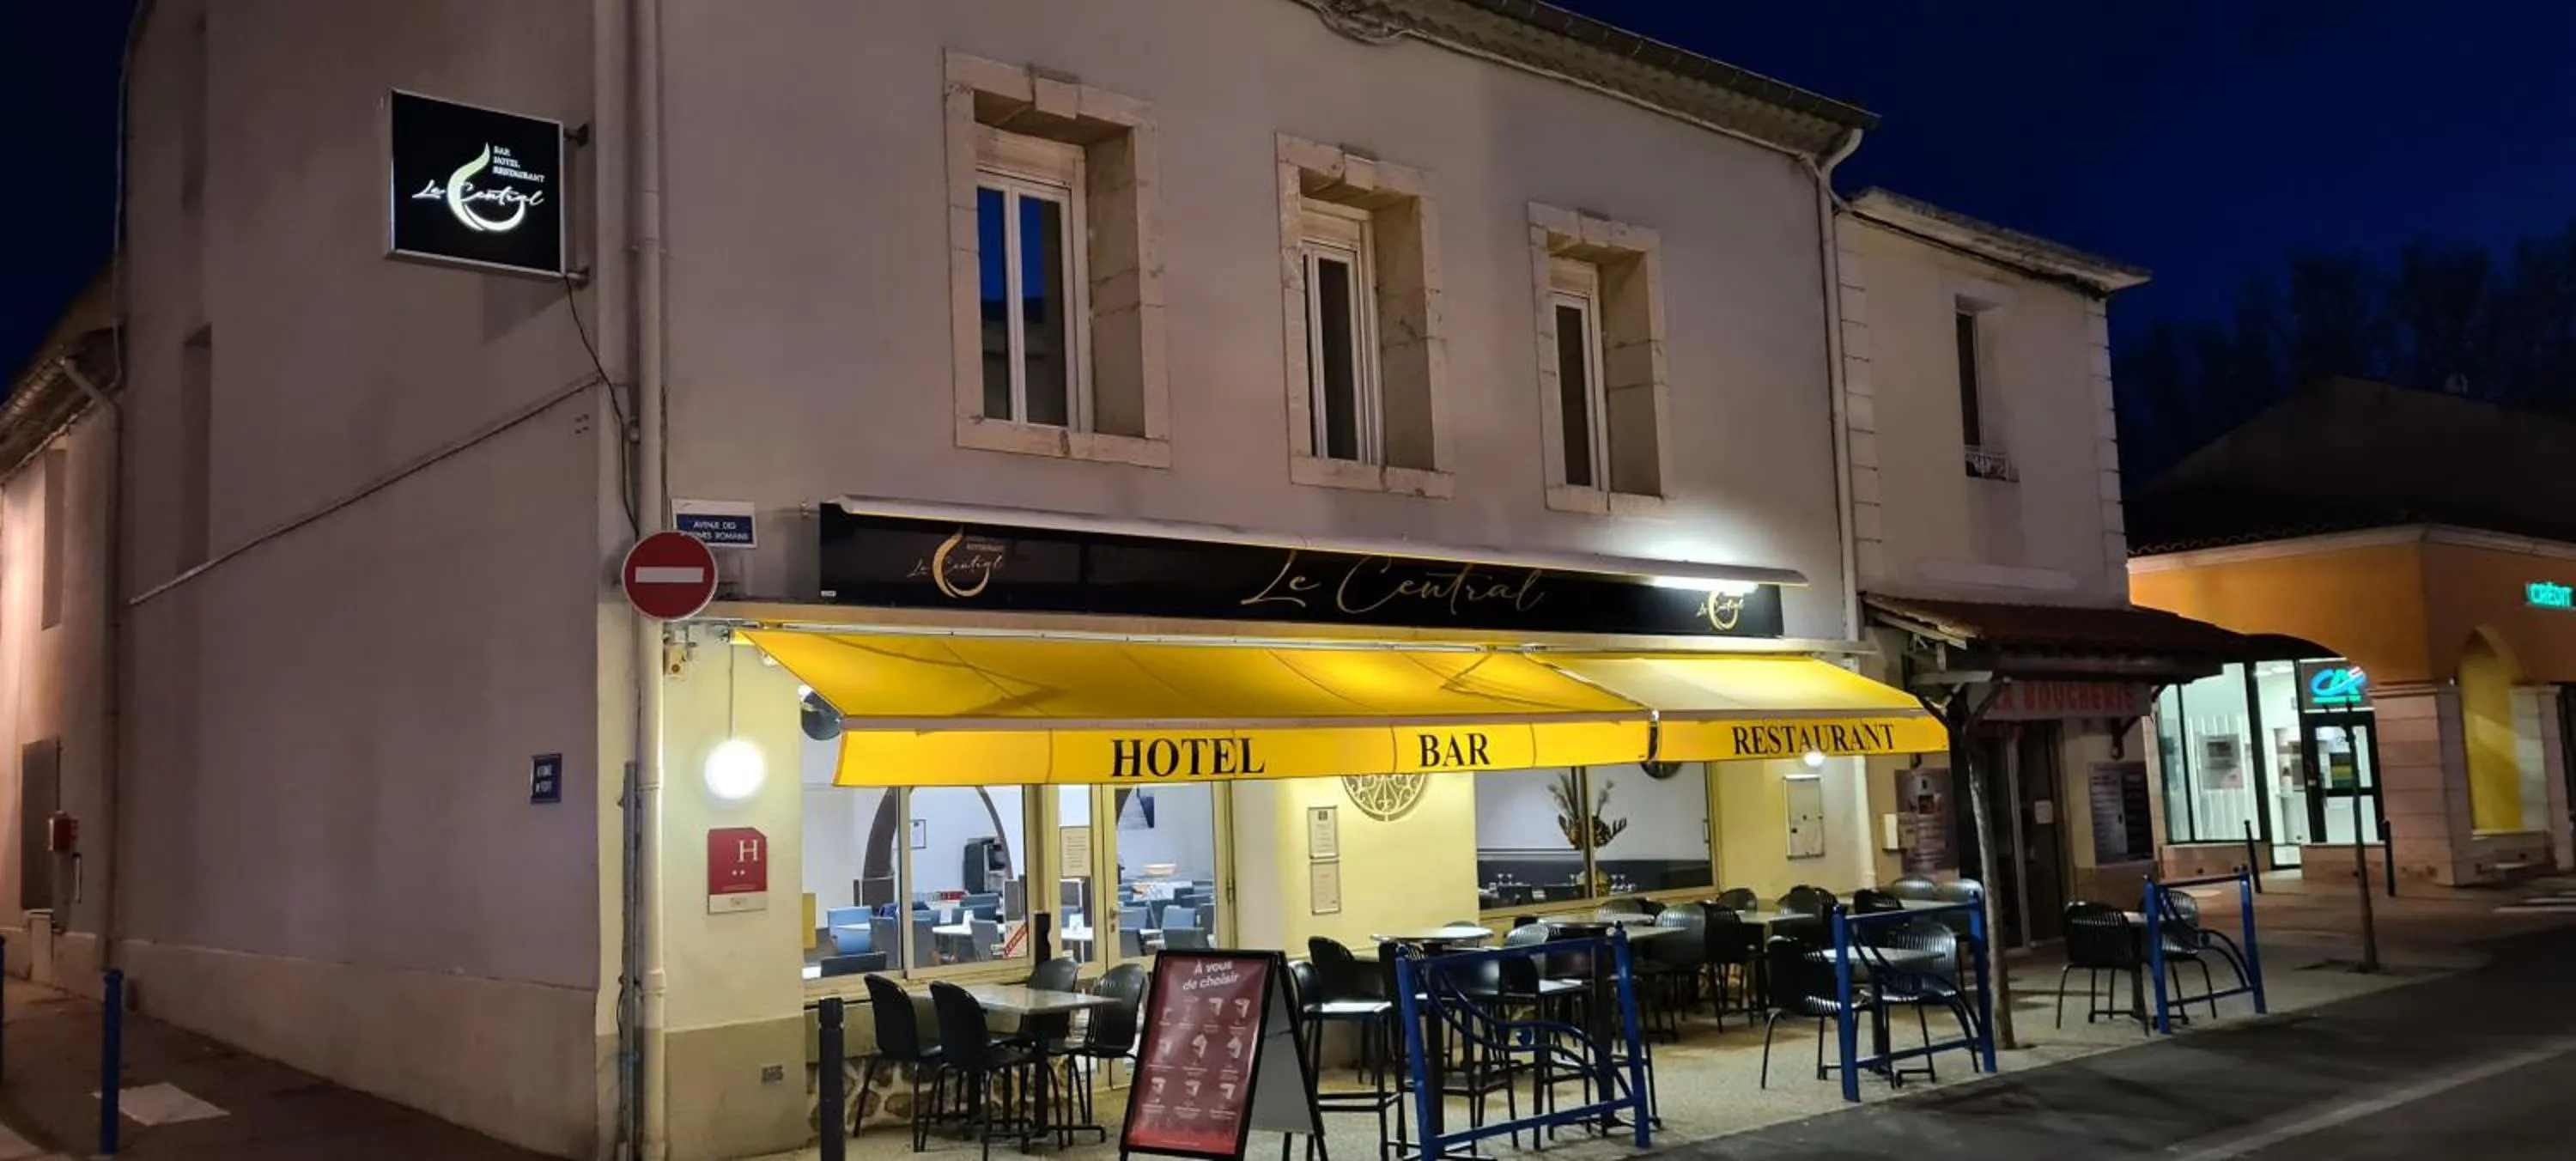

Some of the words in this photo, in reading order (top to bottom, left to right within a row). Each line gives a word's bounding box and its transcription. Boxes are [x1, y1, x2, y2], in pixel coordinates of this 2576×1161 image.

[412, 179, 446, 199] Le
[459, 180, 544, 206] Central
[1241, 548, 1320, 608] Le
[1336, 551, 1546, 615] Central
[1731, 724, 1896, 756] RESTAURANT
[1111, 736, 1265, 777] HOTEL
[1418, 732, 1491, 768] BAR
[738, 839, 759, 862] H
[1206, 960, 1233, 973] vous
[1182, 978, 1198, 990] de
